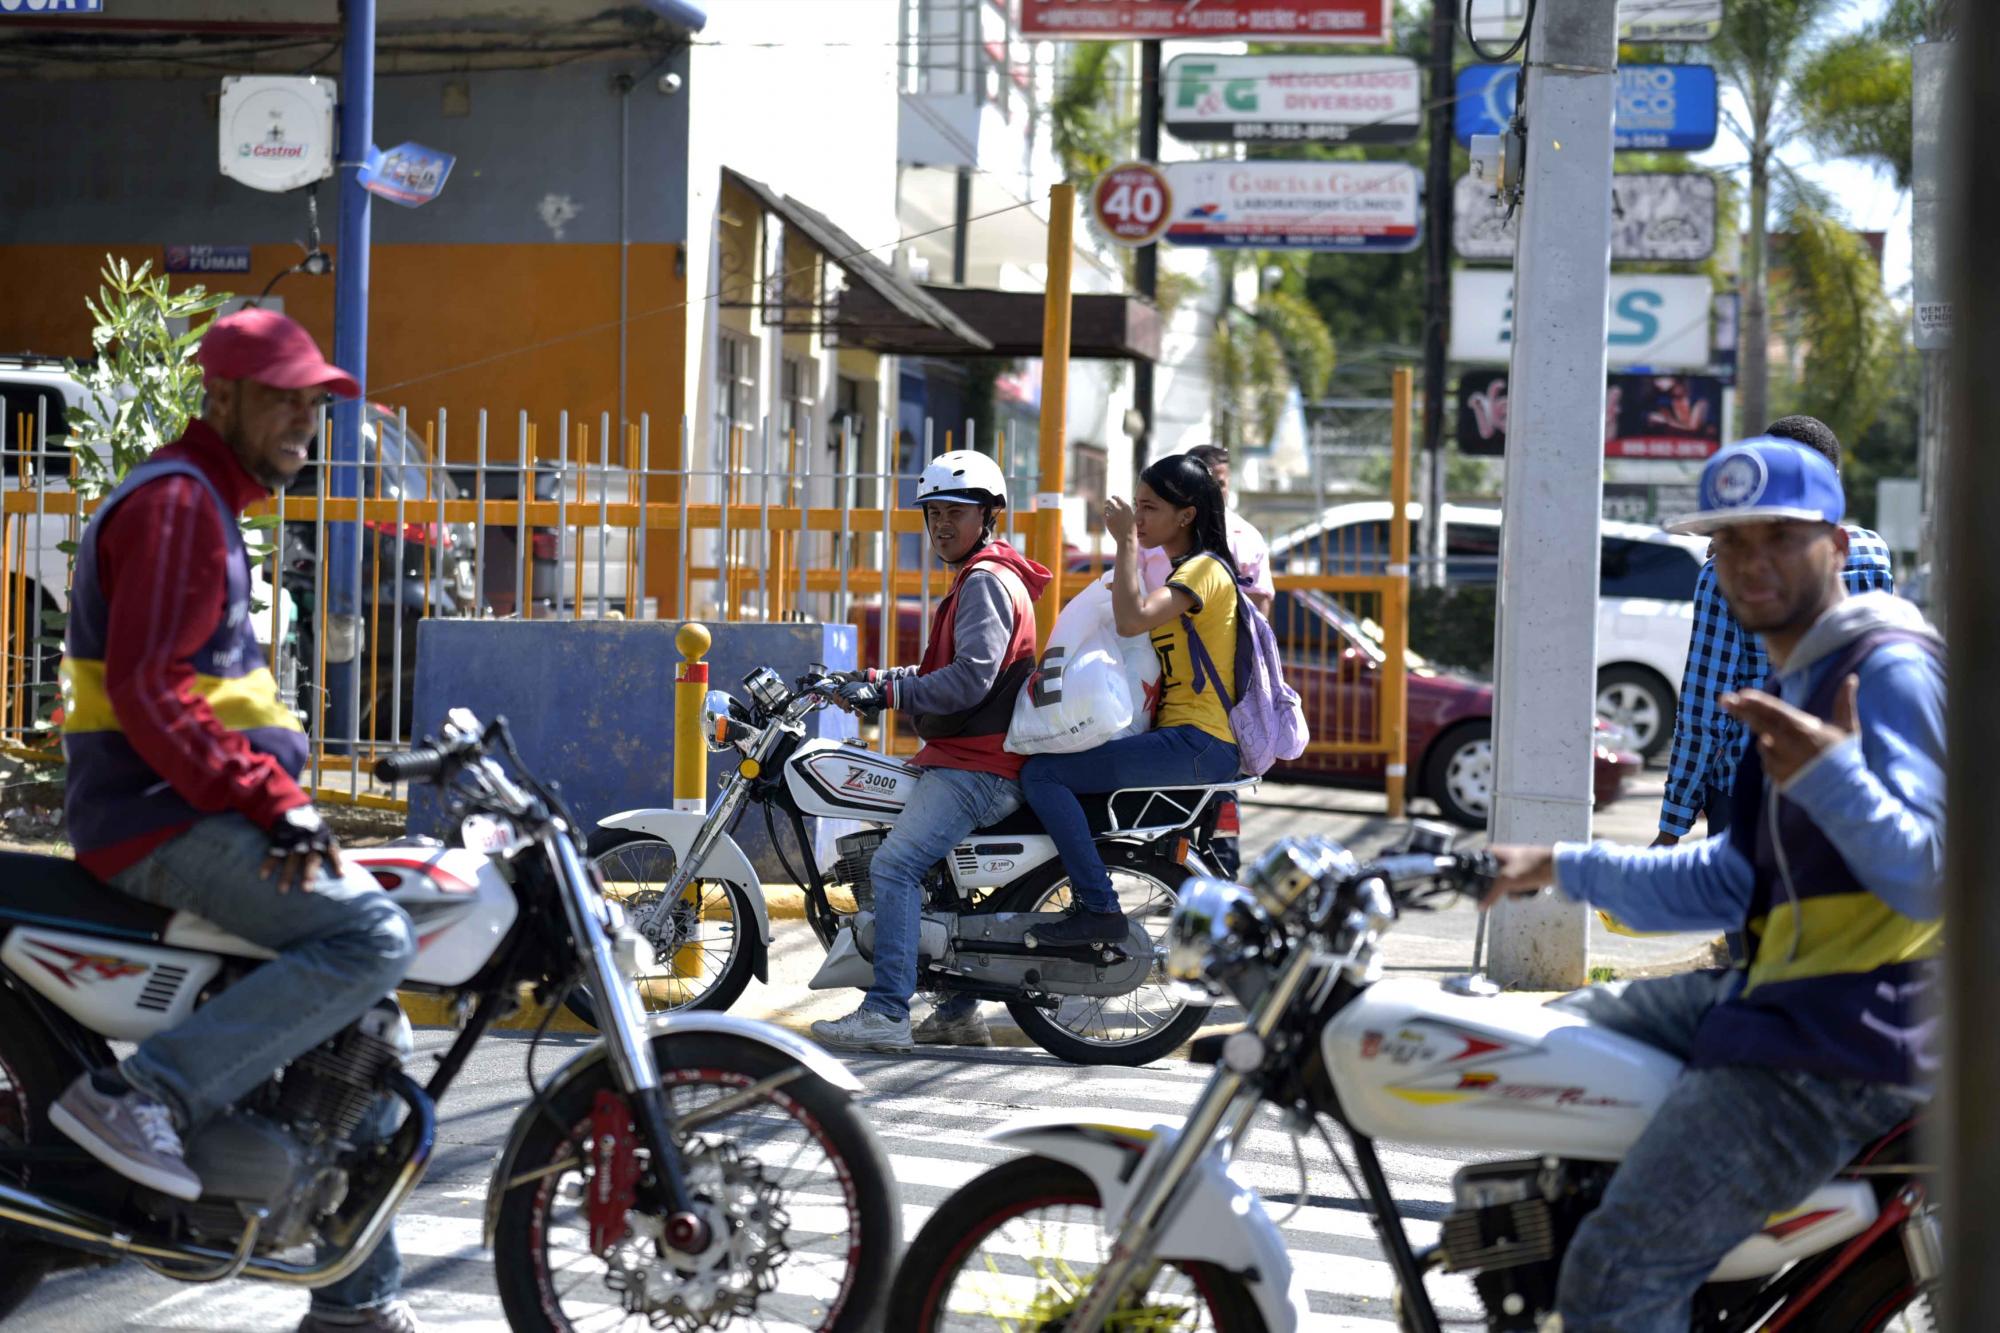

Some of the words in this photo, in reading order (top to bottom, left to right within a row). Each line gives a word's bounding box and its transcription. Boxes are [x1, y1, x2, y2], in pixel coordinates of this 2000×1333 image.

[1284, 93, 1395, 111] DIVERSOS
[254, 144, 302, 158] Castrol
[1103, 185, 1163, 223] 40
[189, 256, 248, 270] FUMAR
[864, 773, 897, 790] 3000
